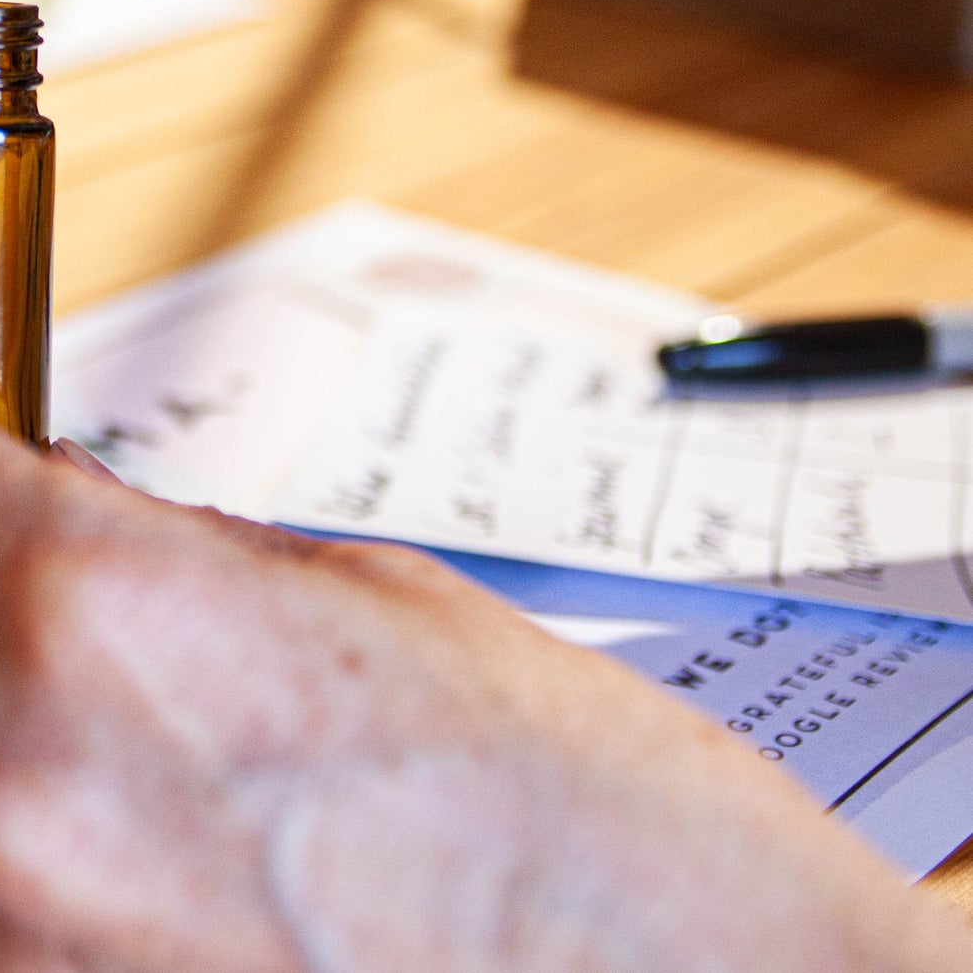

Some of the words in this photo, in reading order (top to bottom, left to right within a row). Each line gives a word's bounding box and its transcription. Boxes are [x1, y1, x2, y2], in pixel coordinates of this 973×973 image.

[662, 650, 735, 690] WE
[726, 632, 877, 734] GRATEFUL
[758, 691, 857, 762] OOGLE
